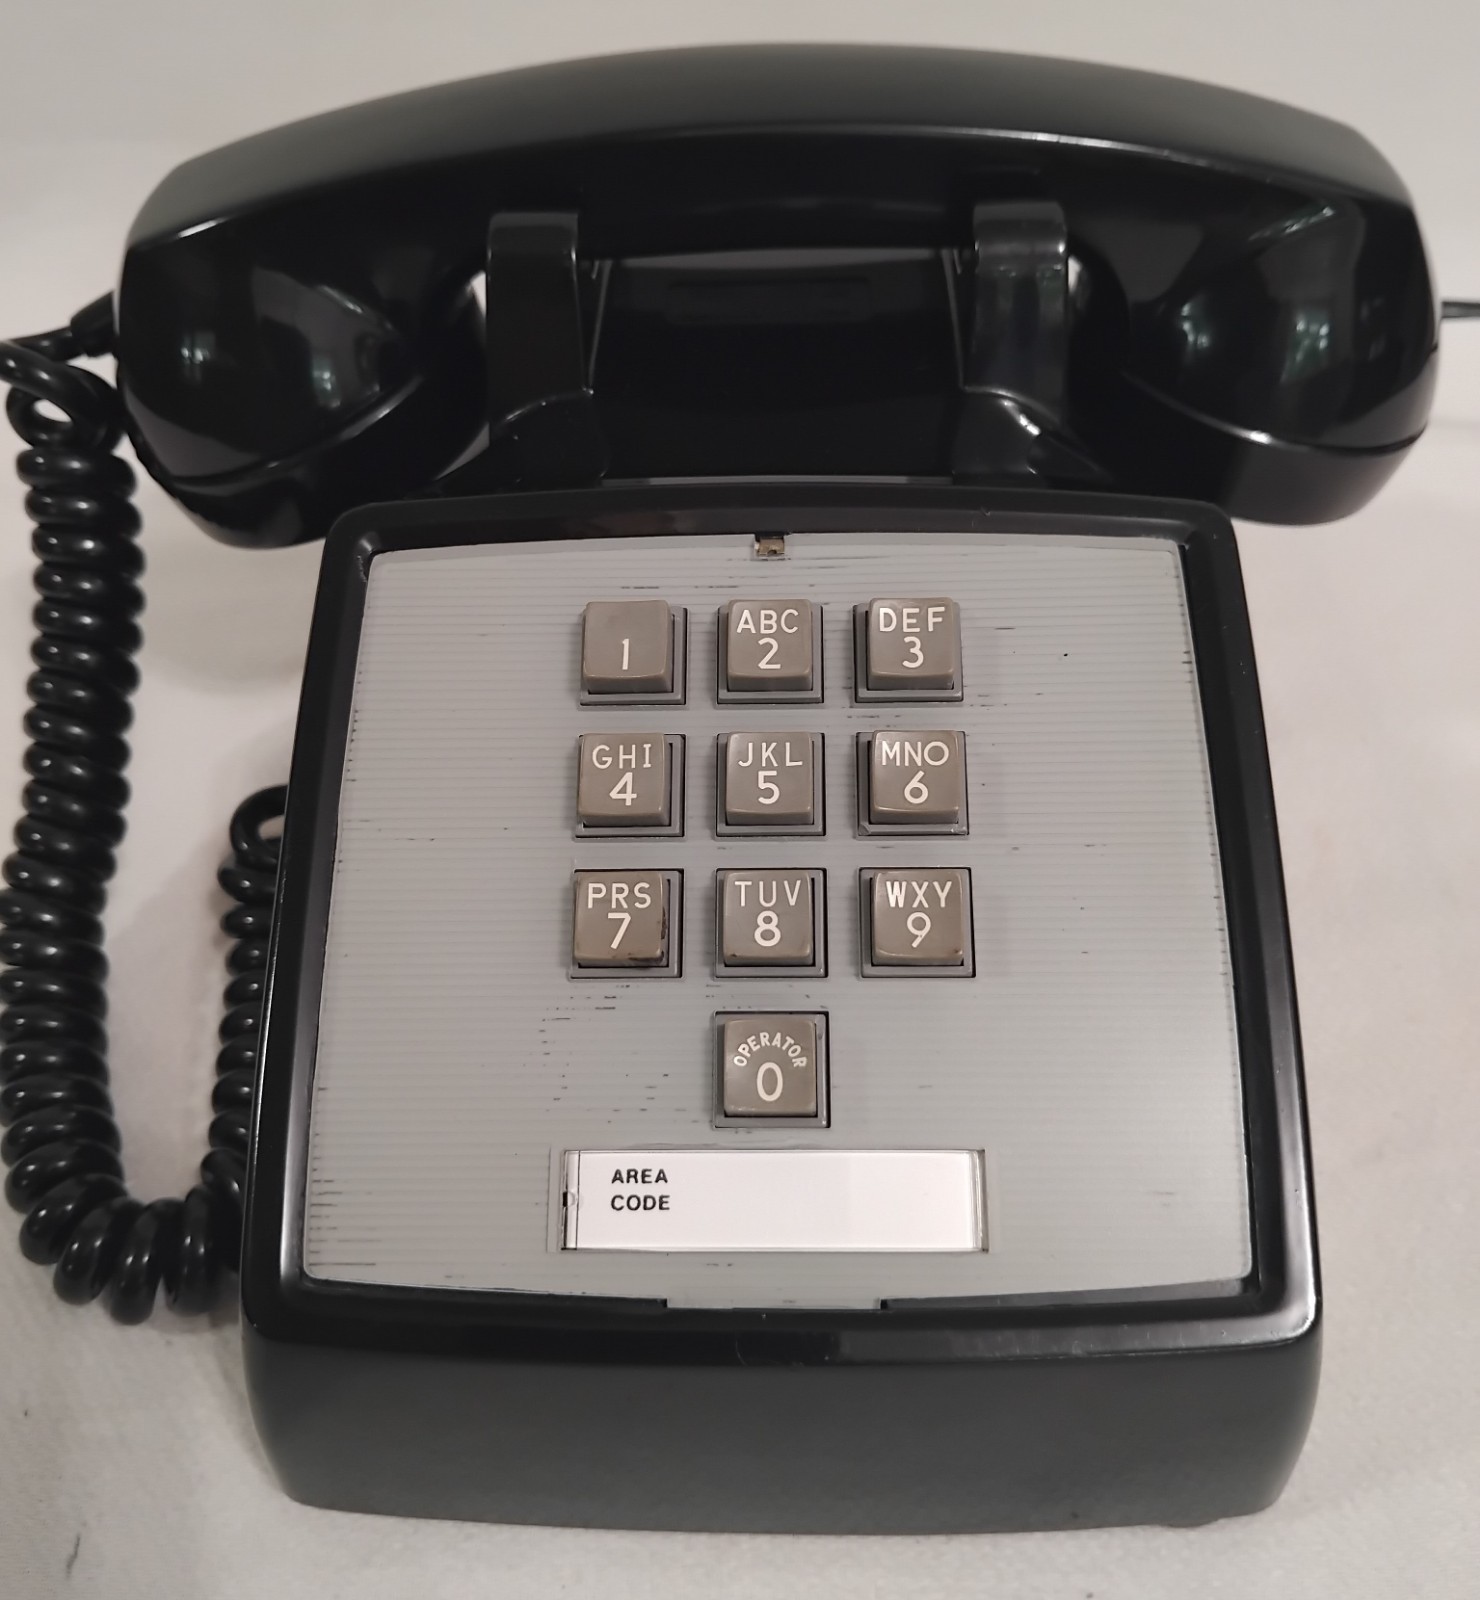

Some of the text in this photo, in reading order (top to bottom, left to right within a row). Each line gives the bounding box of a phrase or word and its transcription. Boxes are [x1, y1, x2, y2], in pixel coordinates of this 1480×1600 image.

[736, 609, 799, 634] ABC
[879, 607, 945, 633] DEF
[621, 638, 629, 670] 1
[758, 638, 781, 669] 2
[902, 637, 924, 668] 3
[592, 744, 652, 769] GHI
[738, 742, 803, 767] JKL
[881, 741, 949, 766] MNO
[609, 772, 637, 806] 4
[758, 771, 780, 804] 5
[904, 770, 928, 804] 6
[588, 882, 651, 908] PRS
[735, 881, 801, 907] TUV
[885, 881, 952, 908] WXY
[607, 912, 632, 949] 7
[754, 911, 781, 947] 8
[906, 912, 931, 948] 9
[733, 1032, 808, 1068] OPERATOR
[756, 1062, 783, 1102] 0
[611, 1169, 669, 1184] AREA
[611, 1195, 670, 1211] CODE
